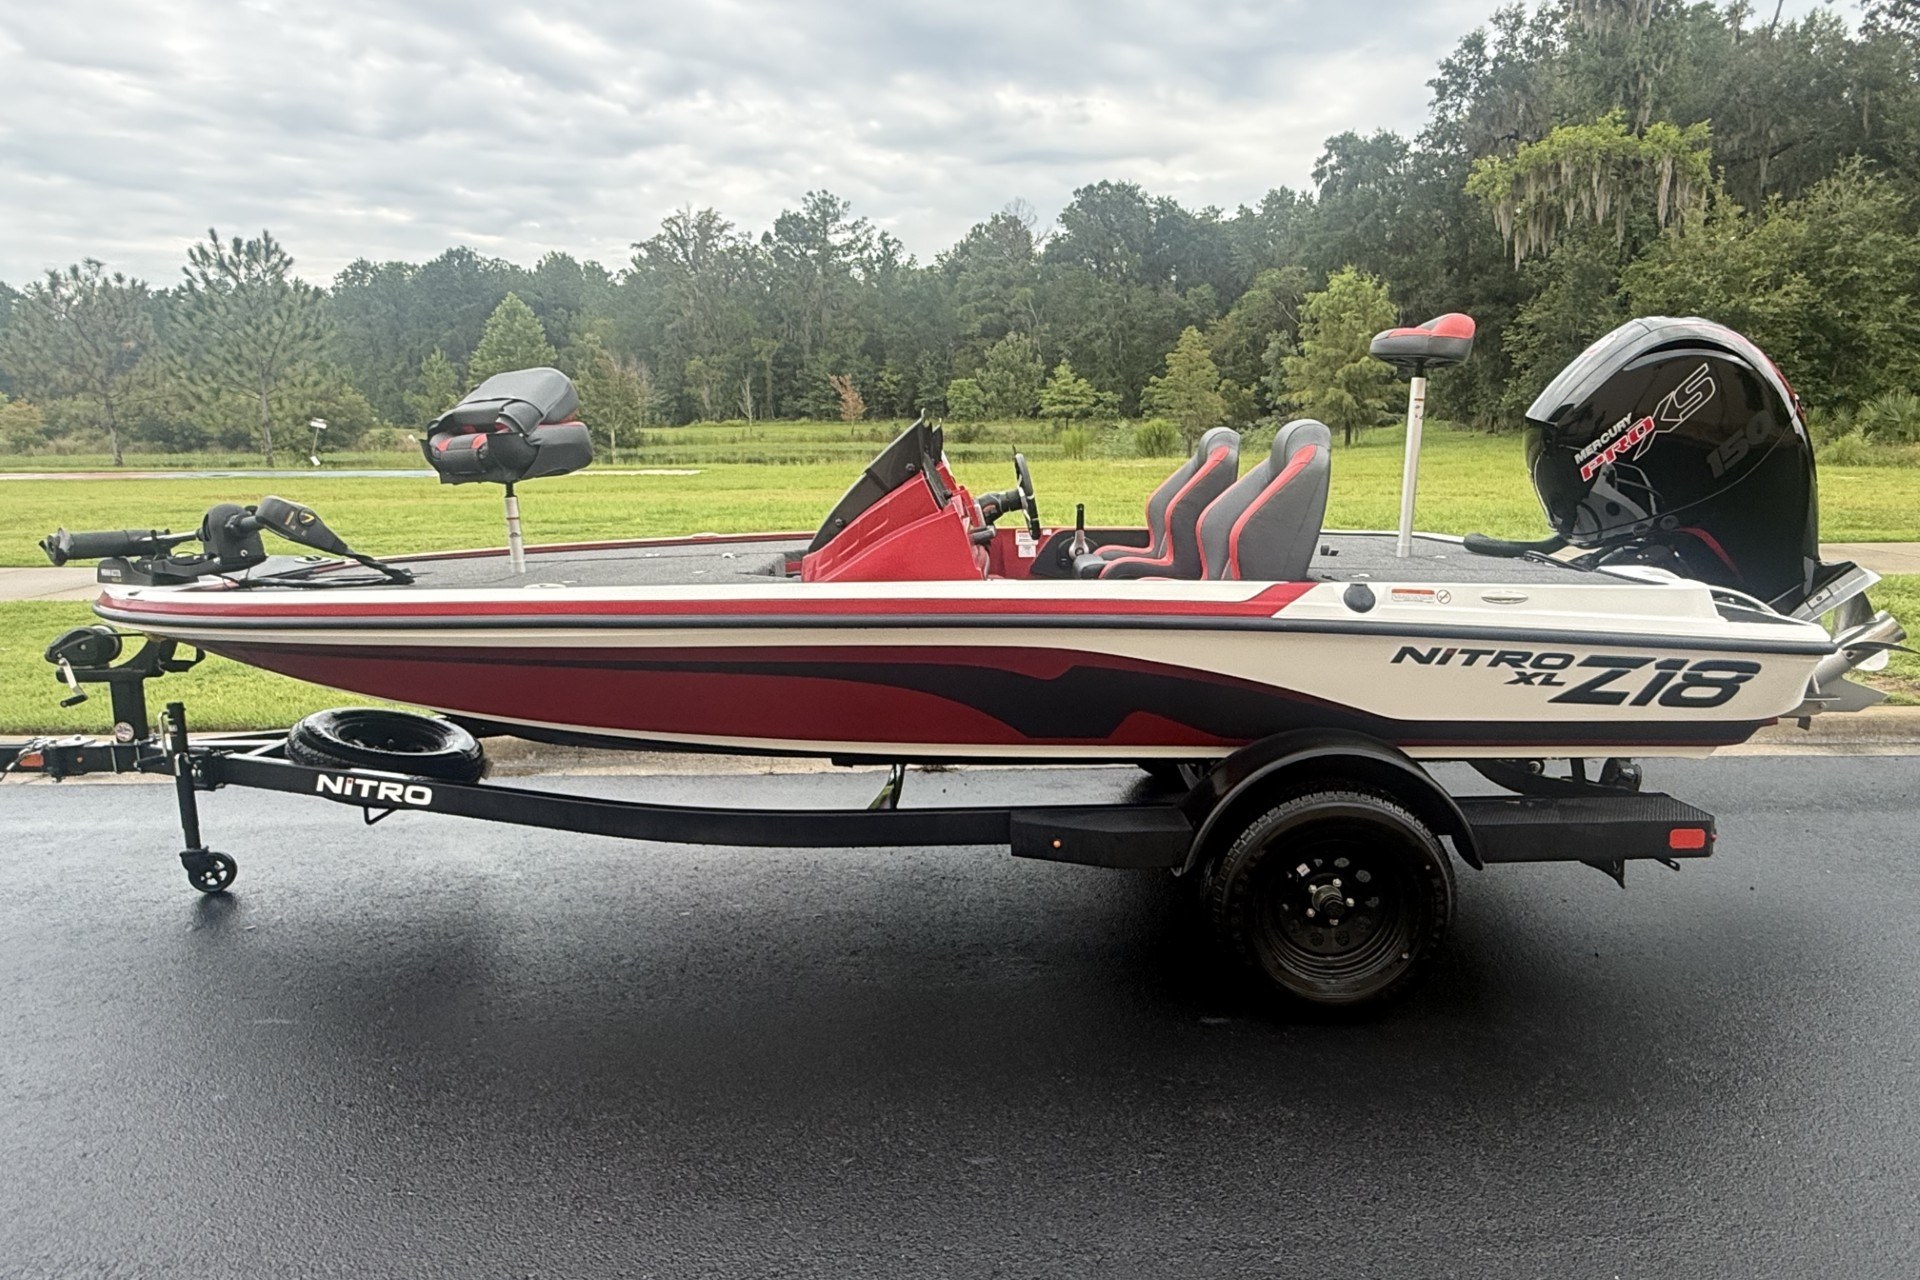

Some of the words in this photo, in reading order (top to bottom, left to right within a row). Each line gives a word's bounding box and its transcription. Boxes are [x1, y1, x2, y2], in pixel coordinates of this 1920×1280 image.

[1574, 412, 1632, 465] MERCURY
[1580, 416, 1655, 482] PRO
[1633, 362, 1716, 461] XS
[1706, 409, 1773, 479] 150
[1390, 645, 1575, 670] NITRO
[1547, 654, 1762, 708] Z18
[1503, 670, 1567, 687] XL
